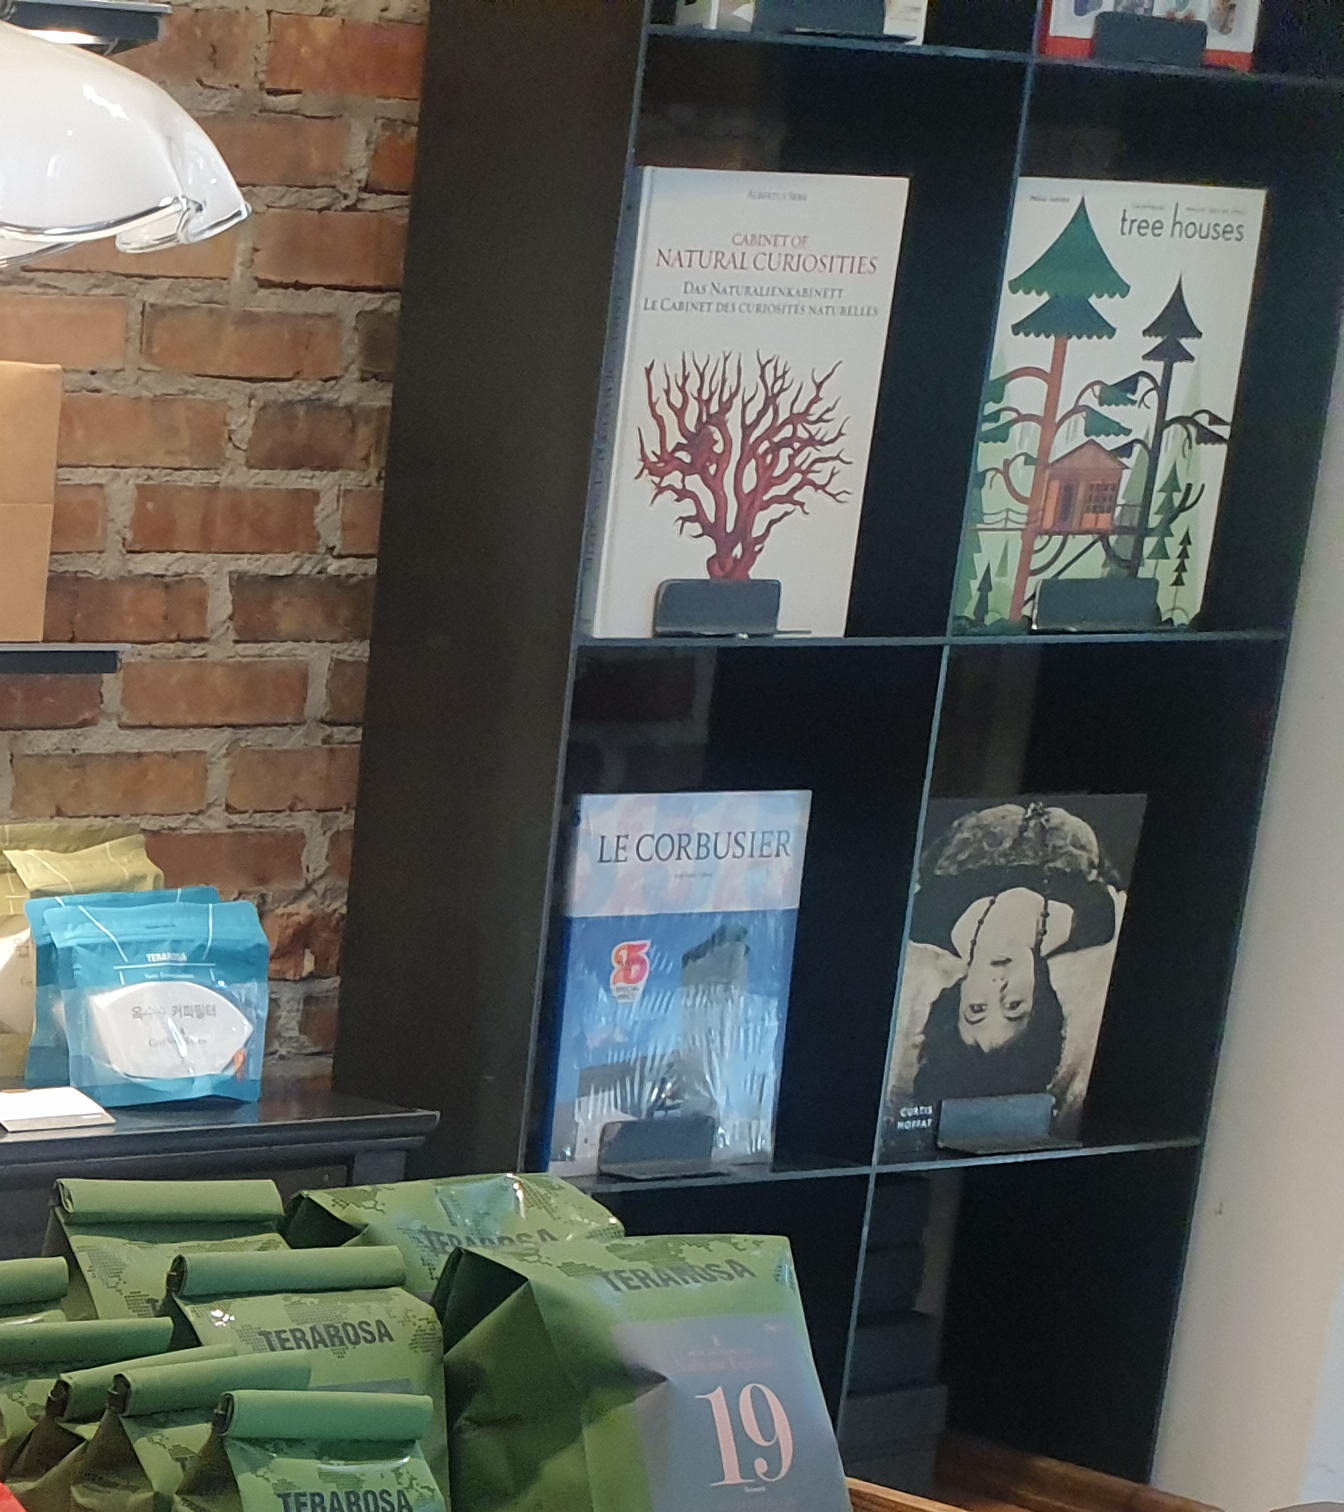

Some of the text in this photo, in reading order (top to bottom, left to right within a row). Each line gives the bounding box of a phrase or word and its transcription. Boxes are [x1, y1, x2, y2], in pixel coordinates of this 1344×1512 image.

[1121, 209, 1164, 236] tree
[1171, 202, 1244, 241] houses
[732, 233, 808, 248] CABINET OF
[657, 249, 878, 274] NATURAL CURIOSITIES
[598, 831, 791, 863] LE CORBUSIER
[602, 1259, 755, 1292] TERAROSA
[258, 1319, 395, 1355] TERAROSA
[696, 1383, 793, 1486] 19
